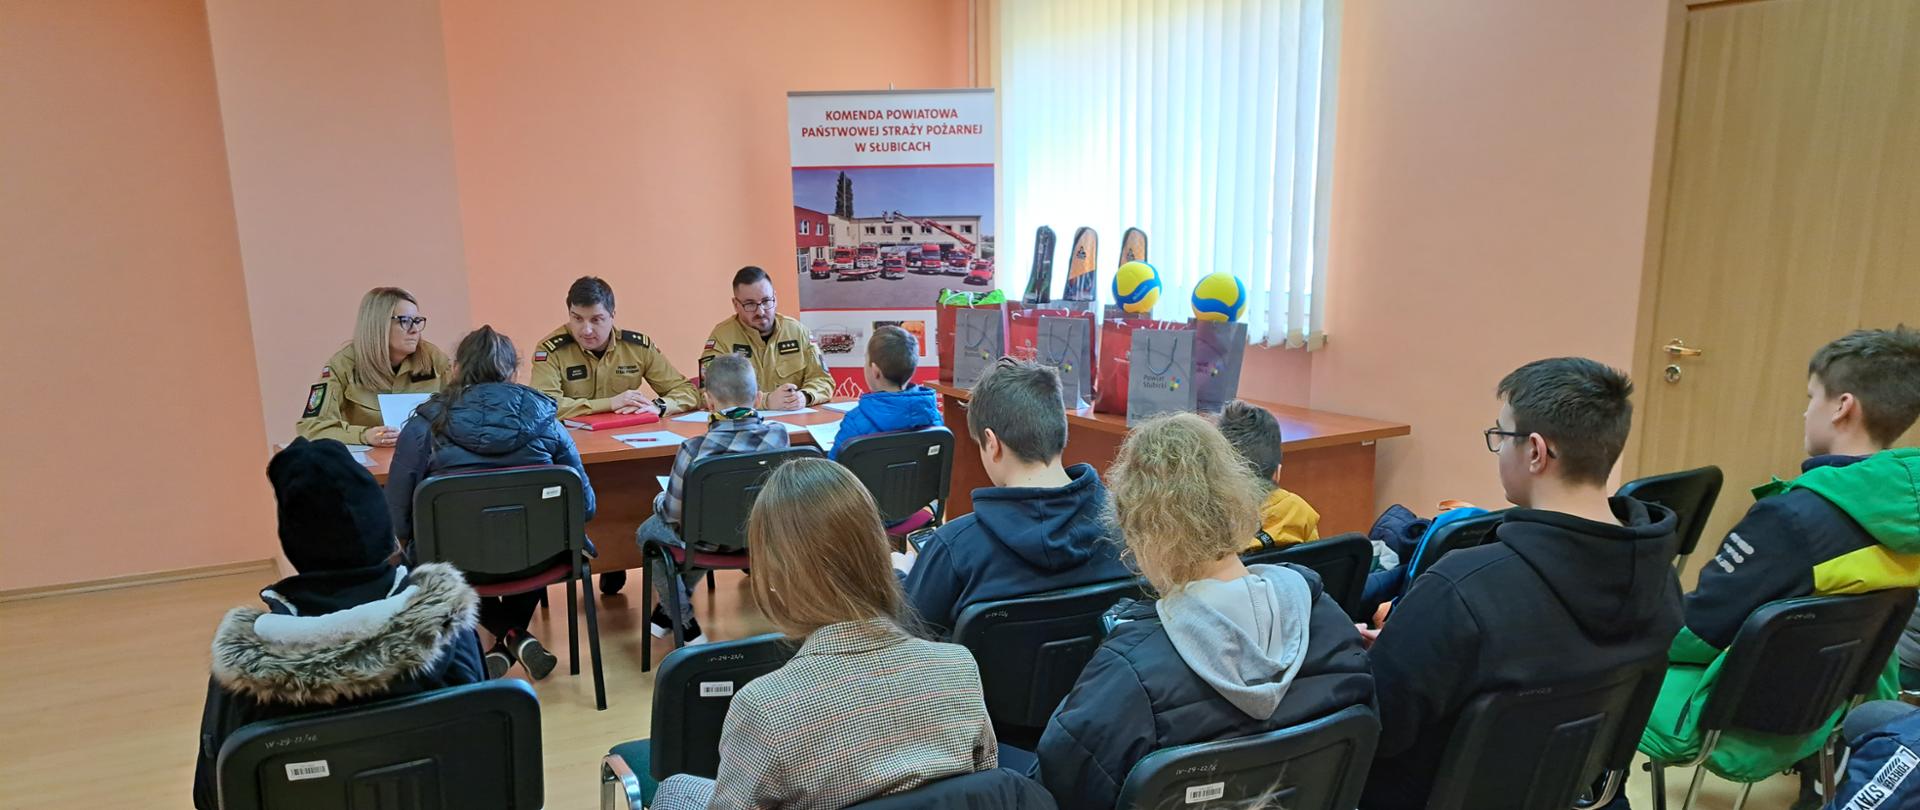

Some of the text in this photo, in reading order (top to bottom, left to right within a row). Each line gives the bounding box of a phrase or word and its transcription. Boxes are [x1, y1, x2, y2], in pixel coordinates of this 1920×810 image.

[825, 109, 958, 121] KOMENDA POWIATOWA
[802, 123, 983, 137] PAŃSTWOWEJ STRAŻY POŻARNEJ
[855, 141, 931, 152] W SŁUBICACH
